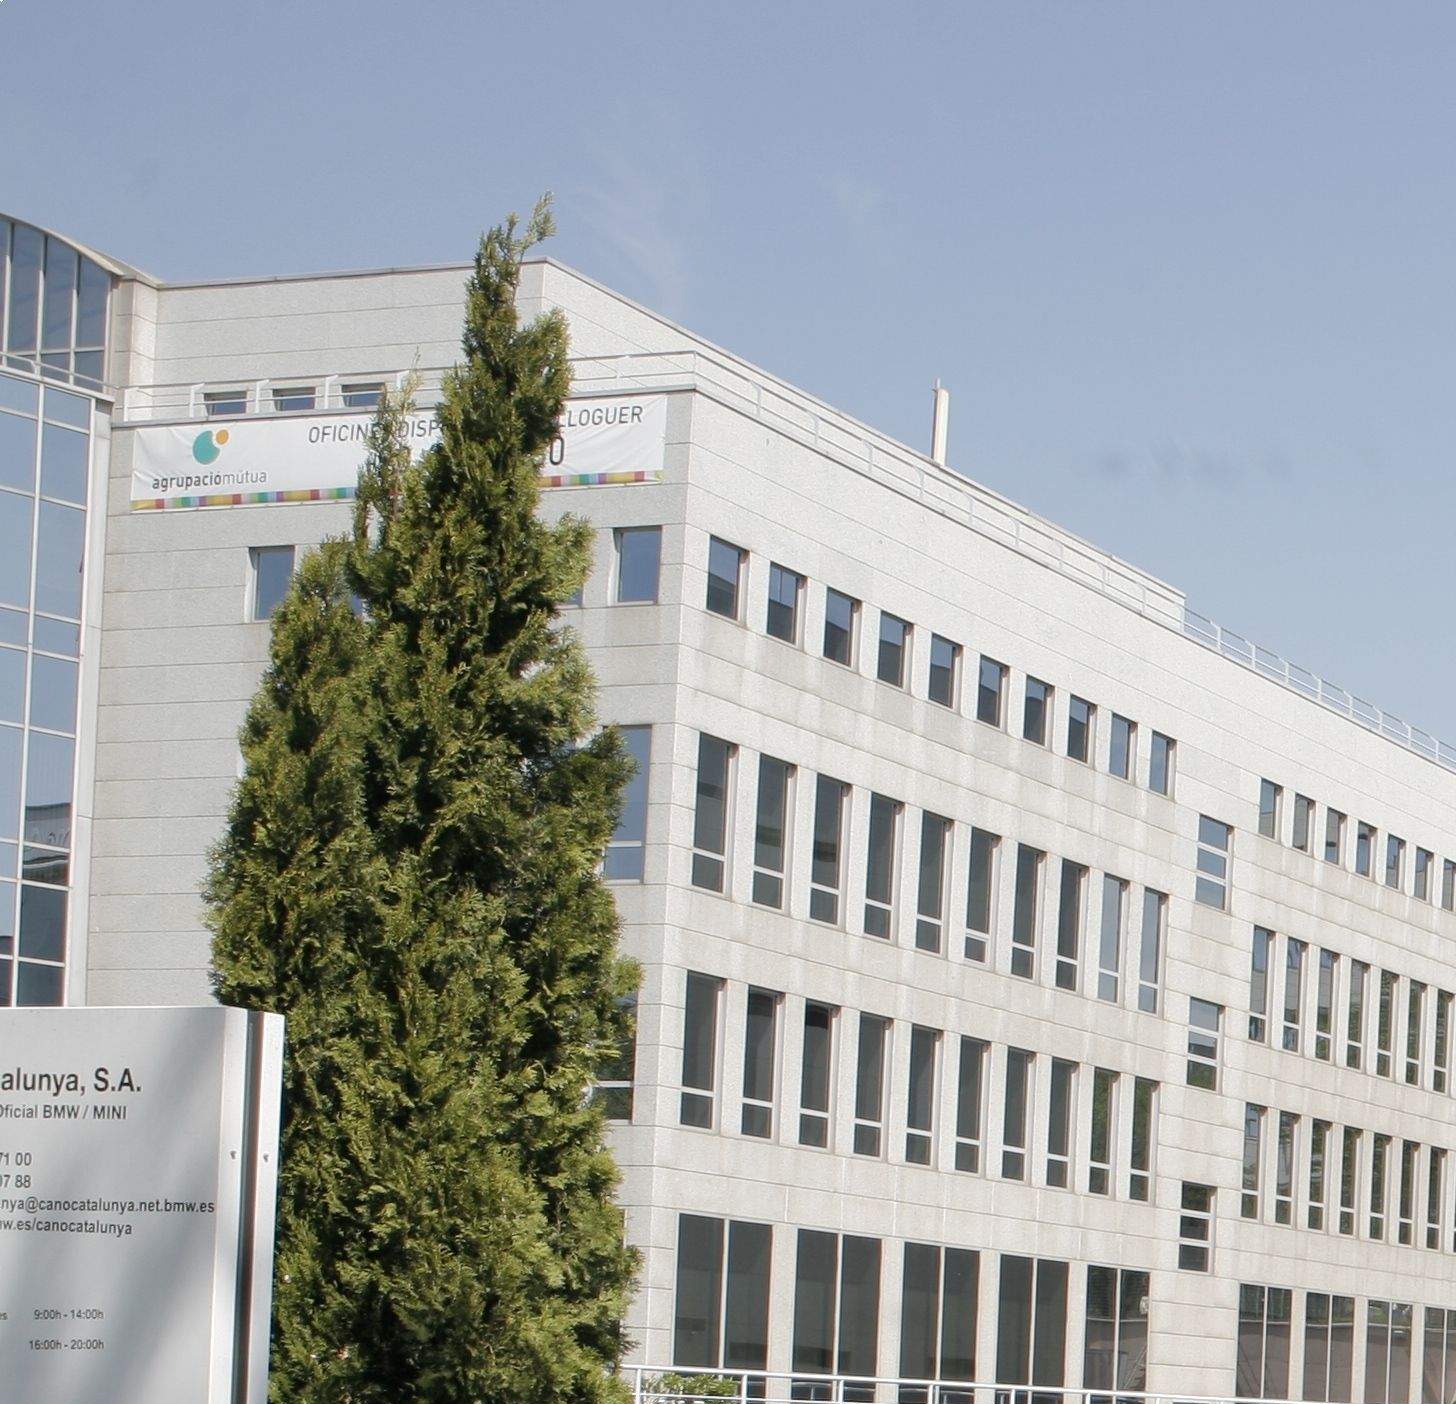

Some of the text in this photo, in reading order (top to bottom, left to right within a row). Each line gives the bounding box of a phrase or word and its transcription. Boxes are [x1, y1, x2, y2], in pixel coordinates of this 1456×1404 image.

[94, 1067, 142, 1092] S.A.
[43, 1104, 79, 1119] BMW
[82, 1105, 89, 1119] /
[93, 1105, 127, 1120] MINI
[15, 1152, 32, 1166] 00
[15, 1174, 31, 1188] 88
[34, 1309, 61, 1320] 9:00h
[70, 1309, 104, 1319] 14:00h
[29, 1340, 61, 1350] 16:00h
[70, 1340, 104, 1349] 20:00h
